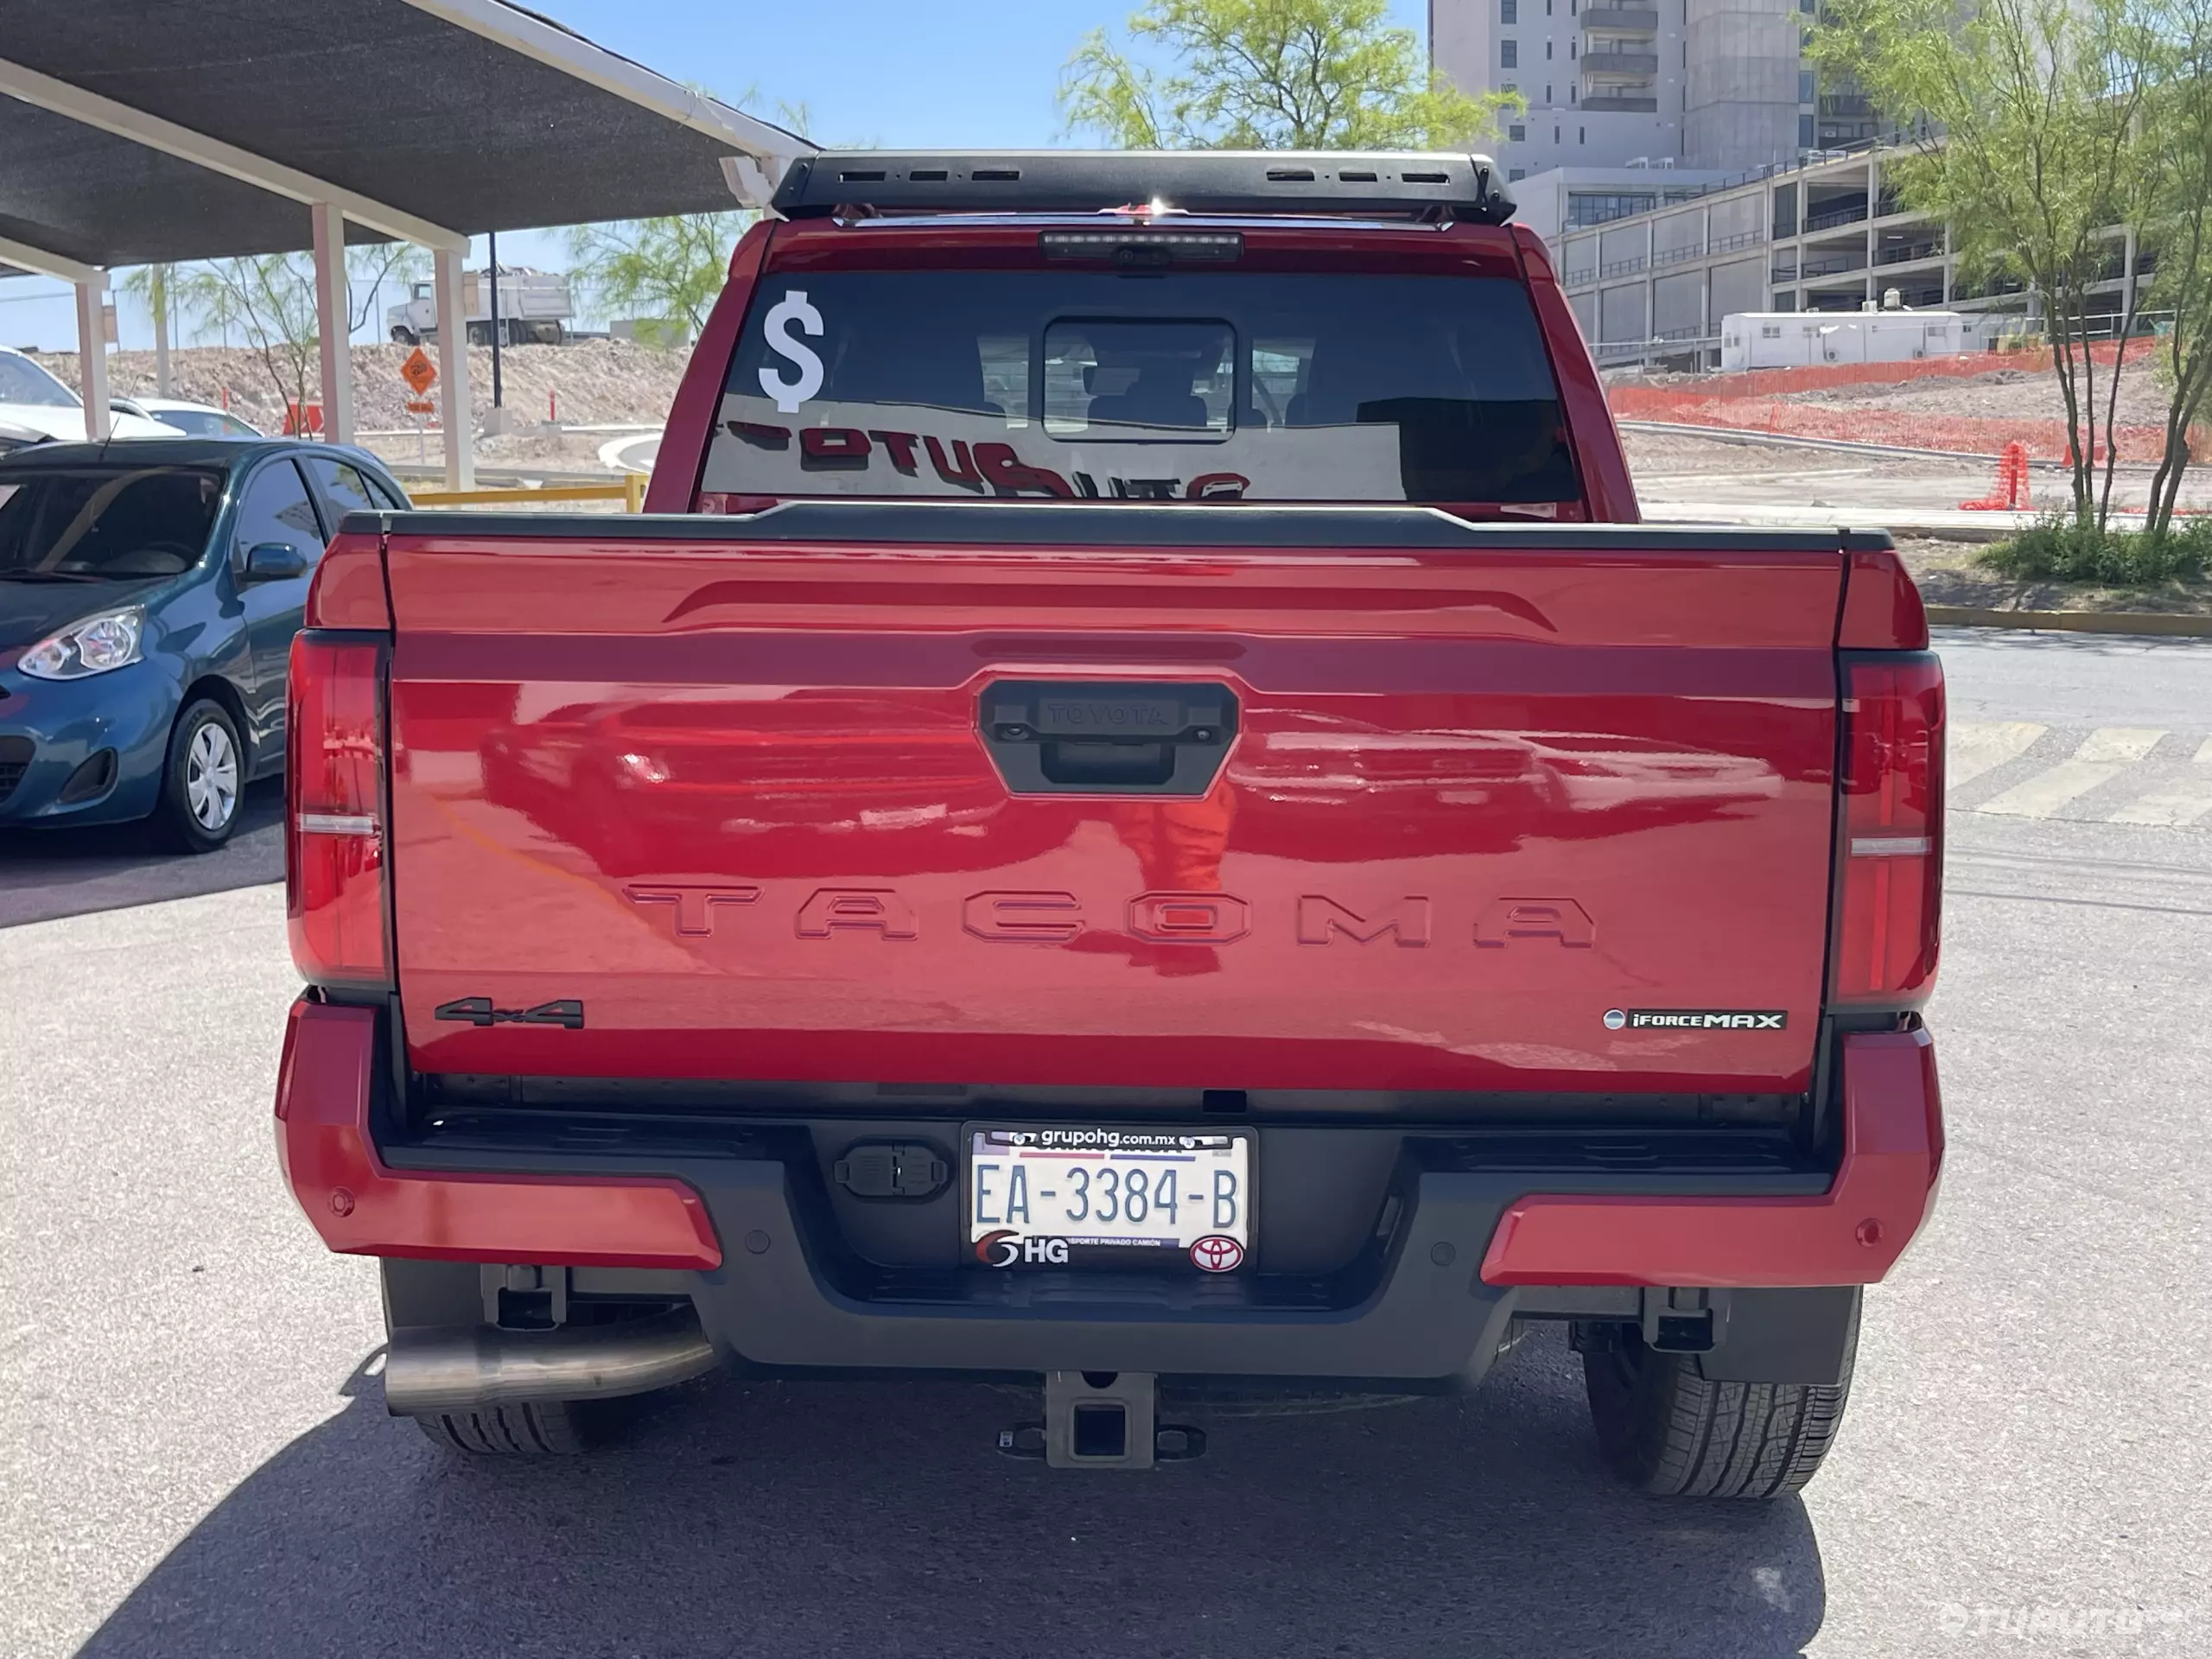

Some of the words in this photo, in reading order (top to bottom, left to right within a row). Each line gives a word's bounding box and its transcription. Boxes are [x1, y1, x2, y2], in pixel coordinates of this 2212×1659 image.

[758, 289, 824, 414] $
[1048, 703, 1170, 724] TOYOTA
[622, 883, 1597, 950] TACOMA
[1041, 1128, 1176, 1147] grupohg.com.mx
[976, 1164, 1237, 1229] EA-3384-B
[1024, 1238, 1069, 1263] HG
